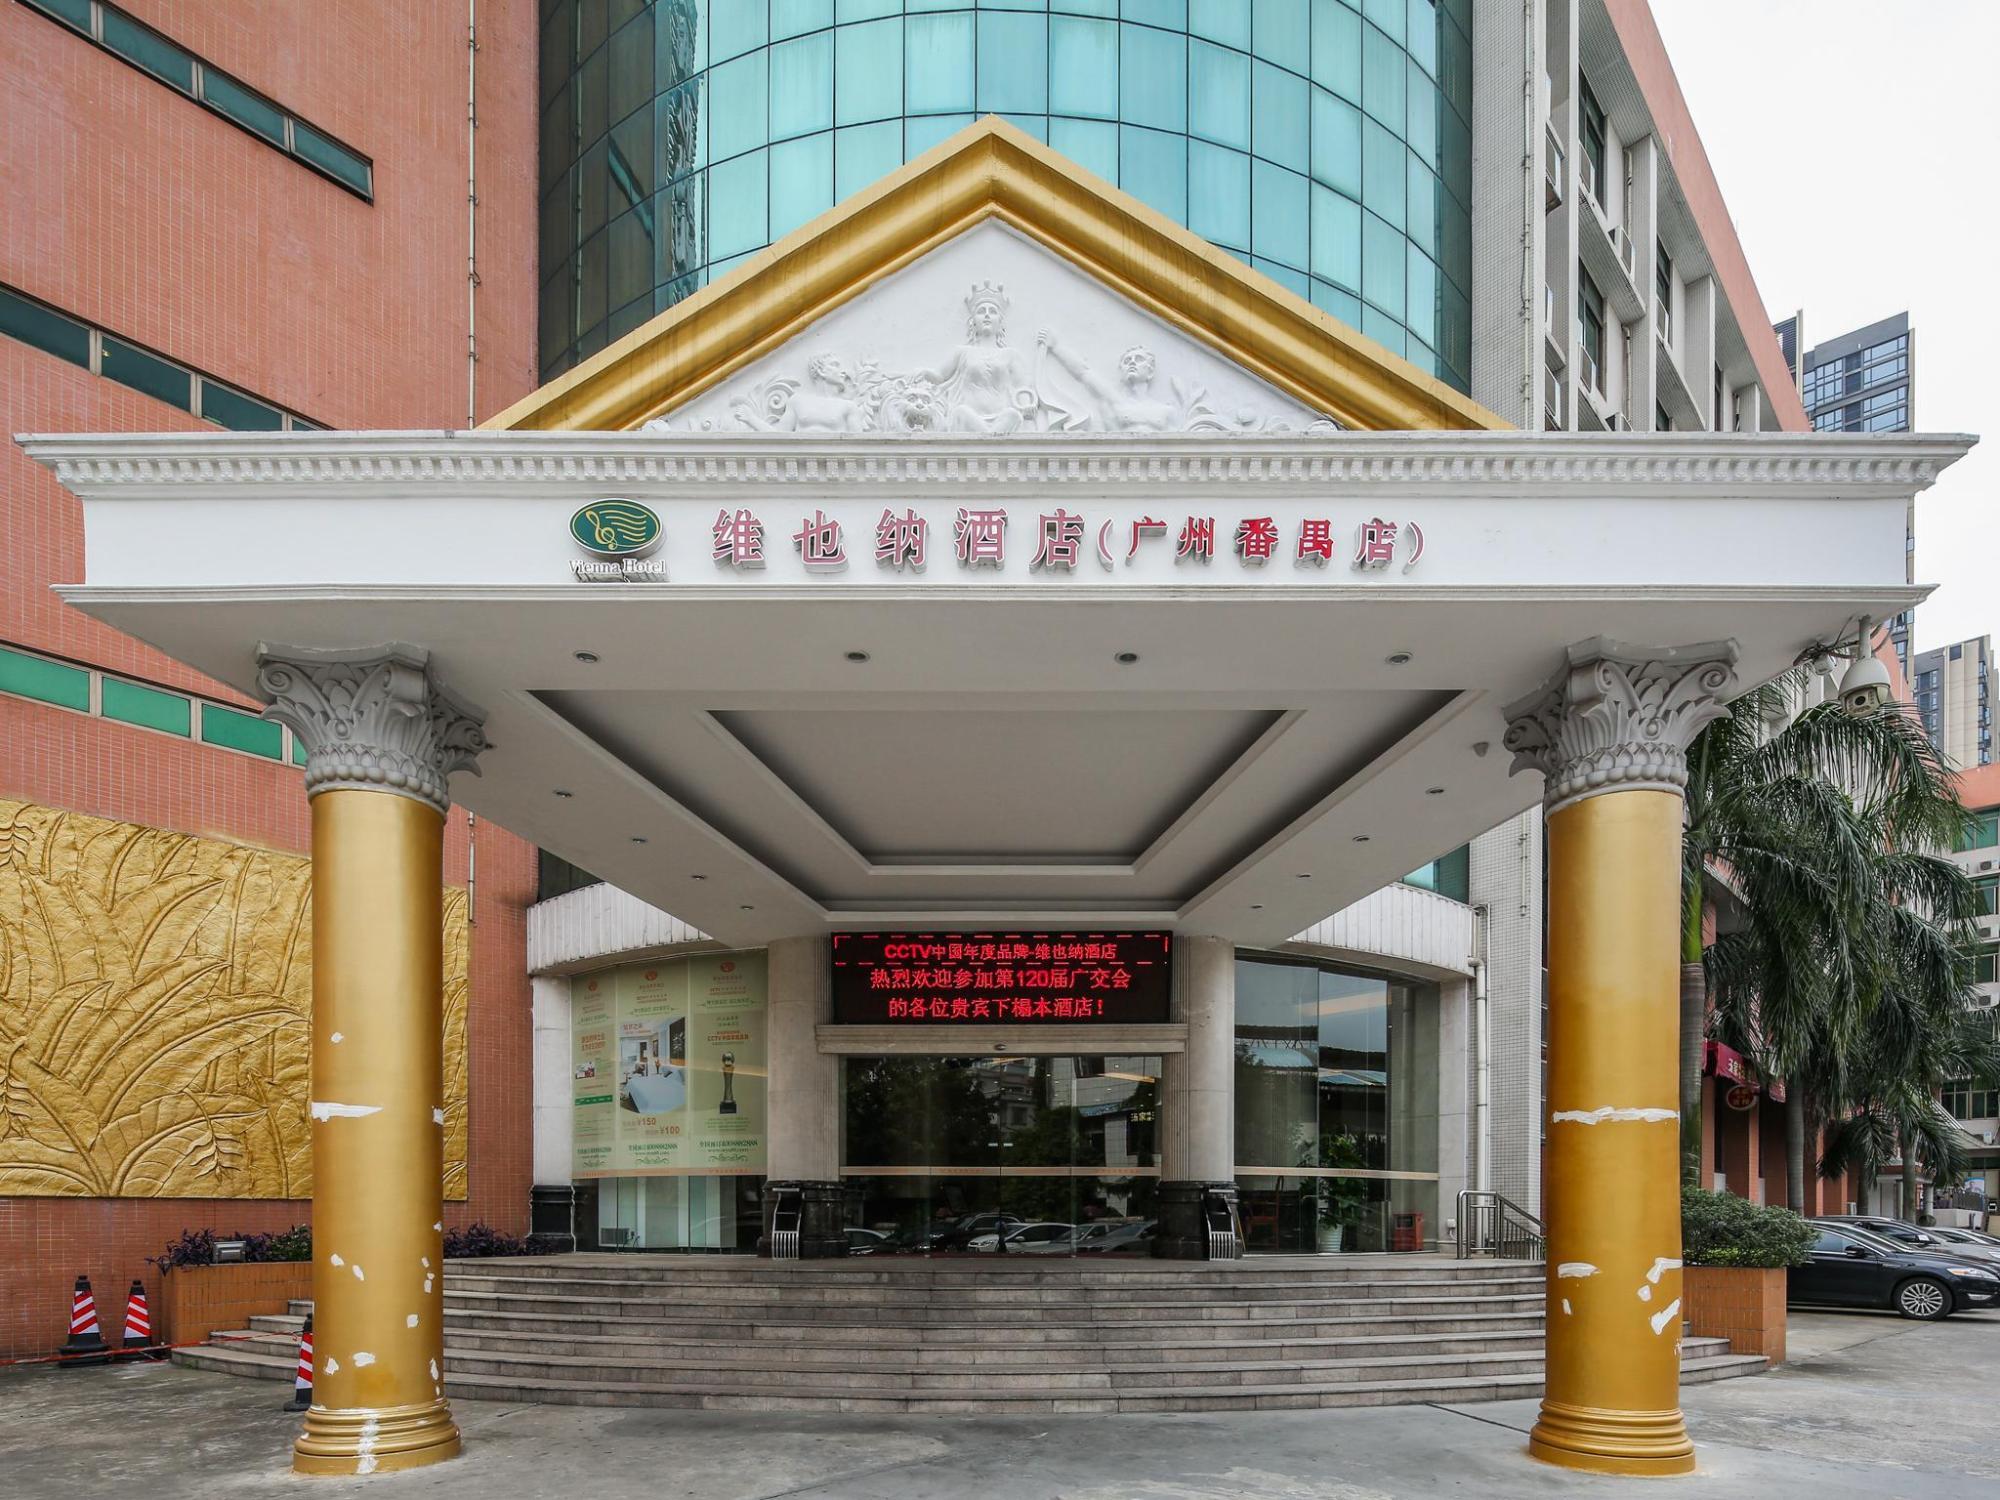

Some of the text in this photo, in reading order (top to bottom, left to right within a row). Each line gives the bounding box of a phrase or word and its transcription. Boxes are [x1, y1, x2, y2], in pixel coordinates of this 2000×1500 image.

[569, 558, 666, 574] Vienna Hotel
[870, 968, 1132, 989] 热烈欢迎参加第120届广交会
